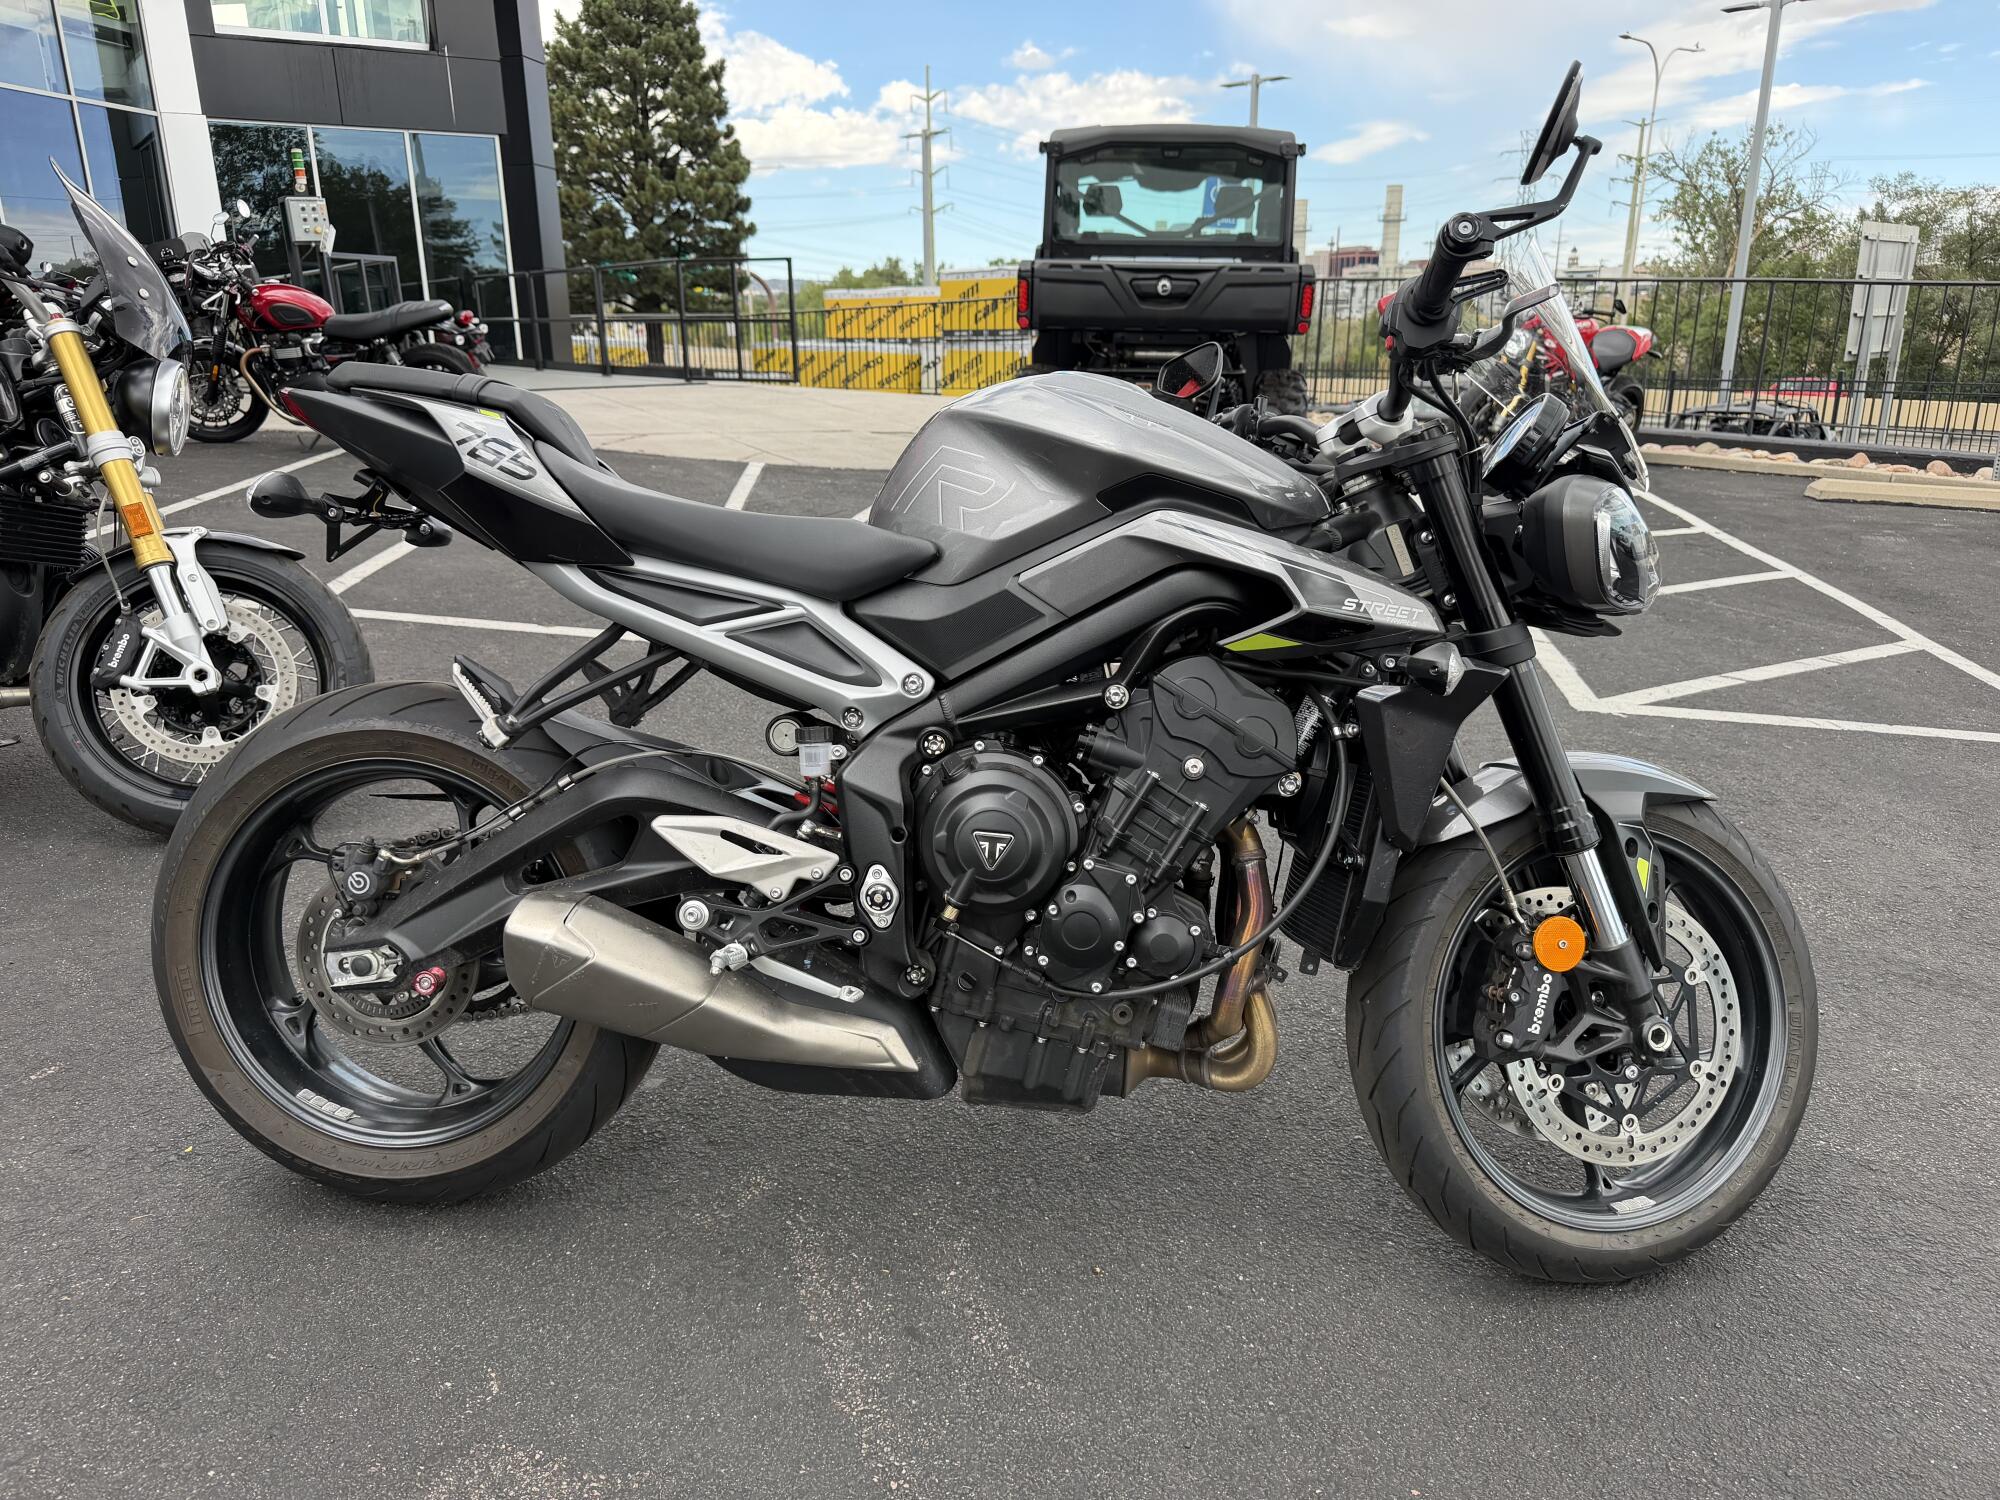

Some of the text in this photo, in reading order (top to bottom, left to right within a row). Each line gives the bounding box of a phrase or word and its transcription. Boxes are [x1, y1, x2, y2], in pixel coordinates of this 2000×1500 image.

[456, 421, 537, 480] 765
[1342, 597, 1423, 621] STREET
[56, 620, 82, 685] MICHELIN
[107, 633, 130, 668] brembo
[1527, 973, 1553, 1034] brembo
